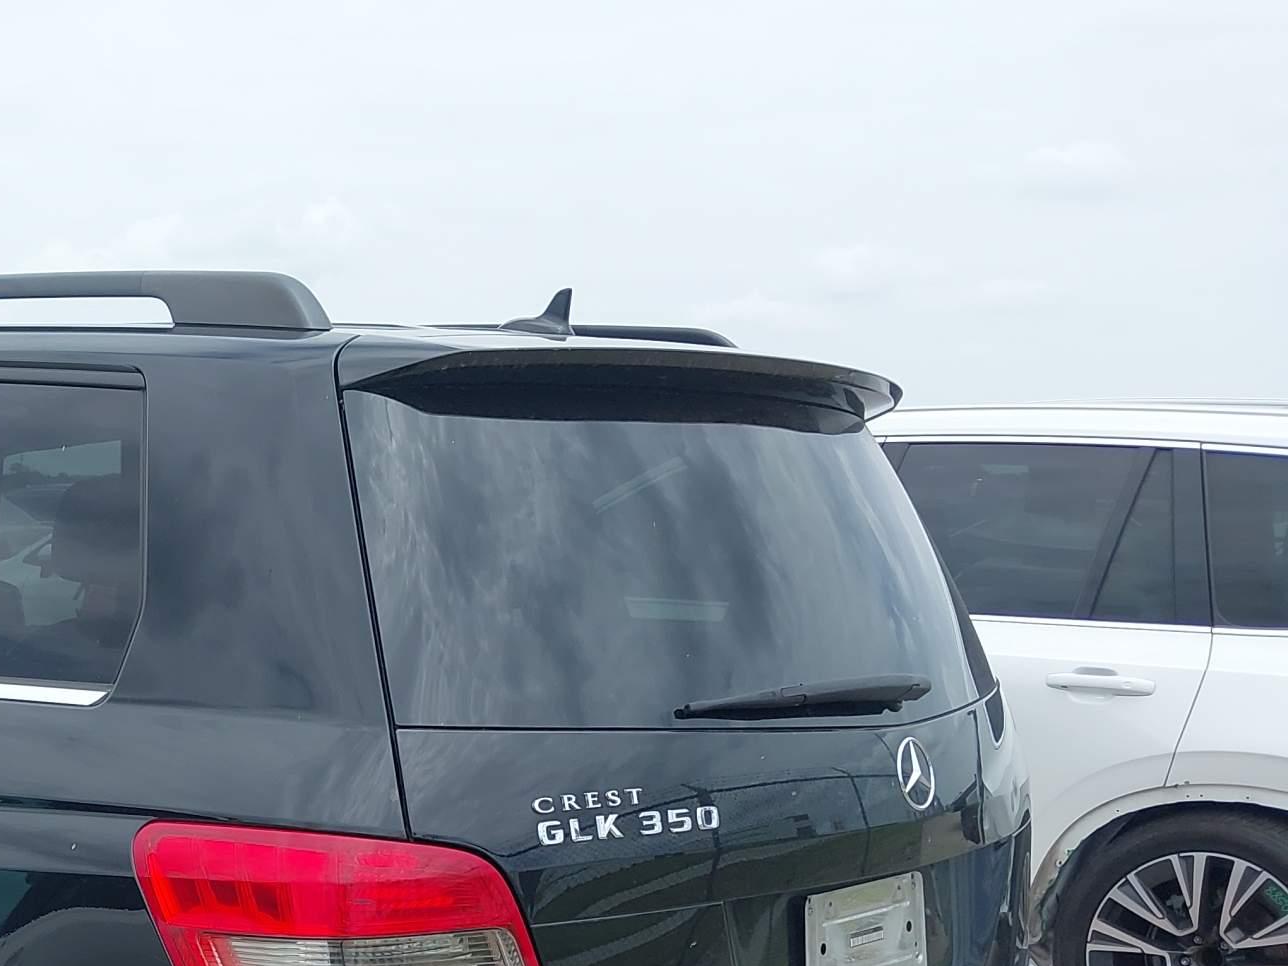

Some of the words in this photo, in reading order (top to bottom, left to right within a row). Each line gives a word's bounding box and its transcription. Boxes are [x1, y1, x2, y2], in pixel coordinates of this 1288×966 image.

[531, 788, 643, 814] CREST
[537, 813, 625, 846] GLK
[638, 805, 721, 836] 350
